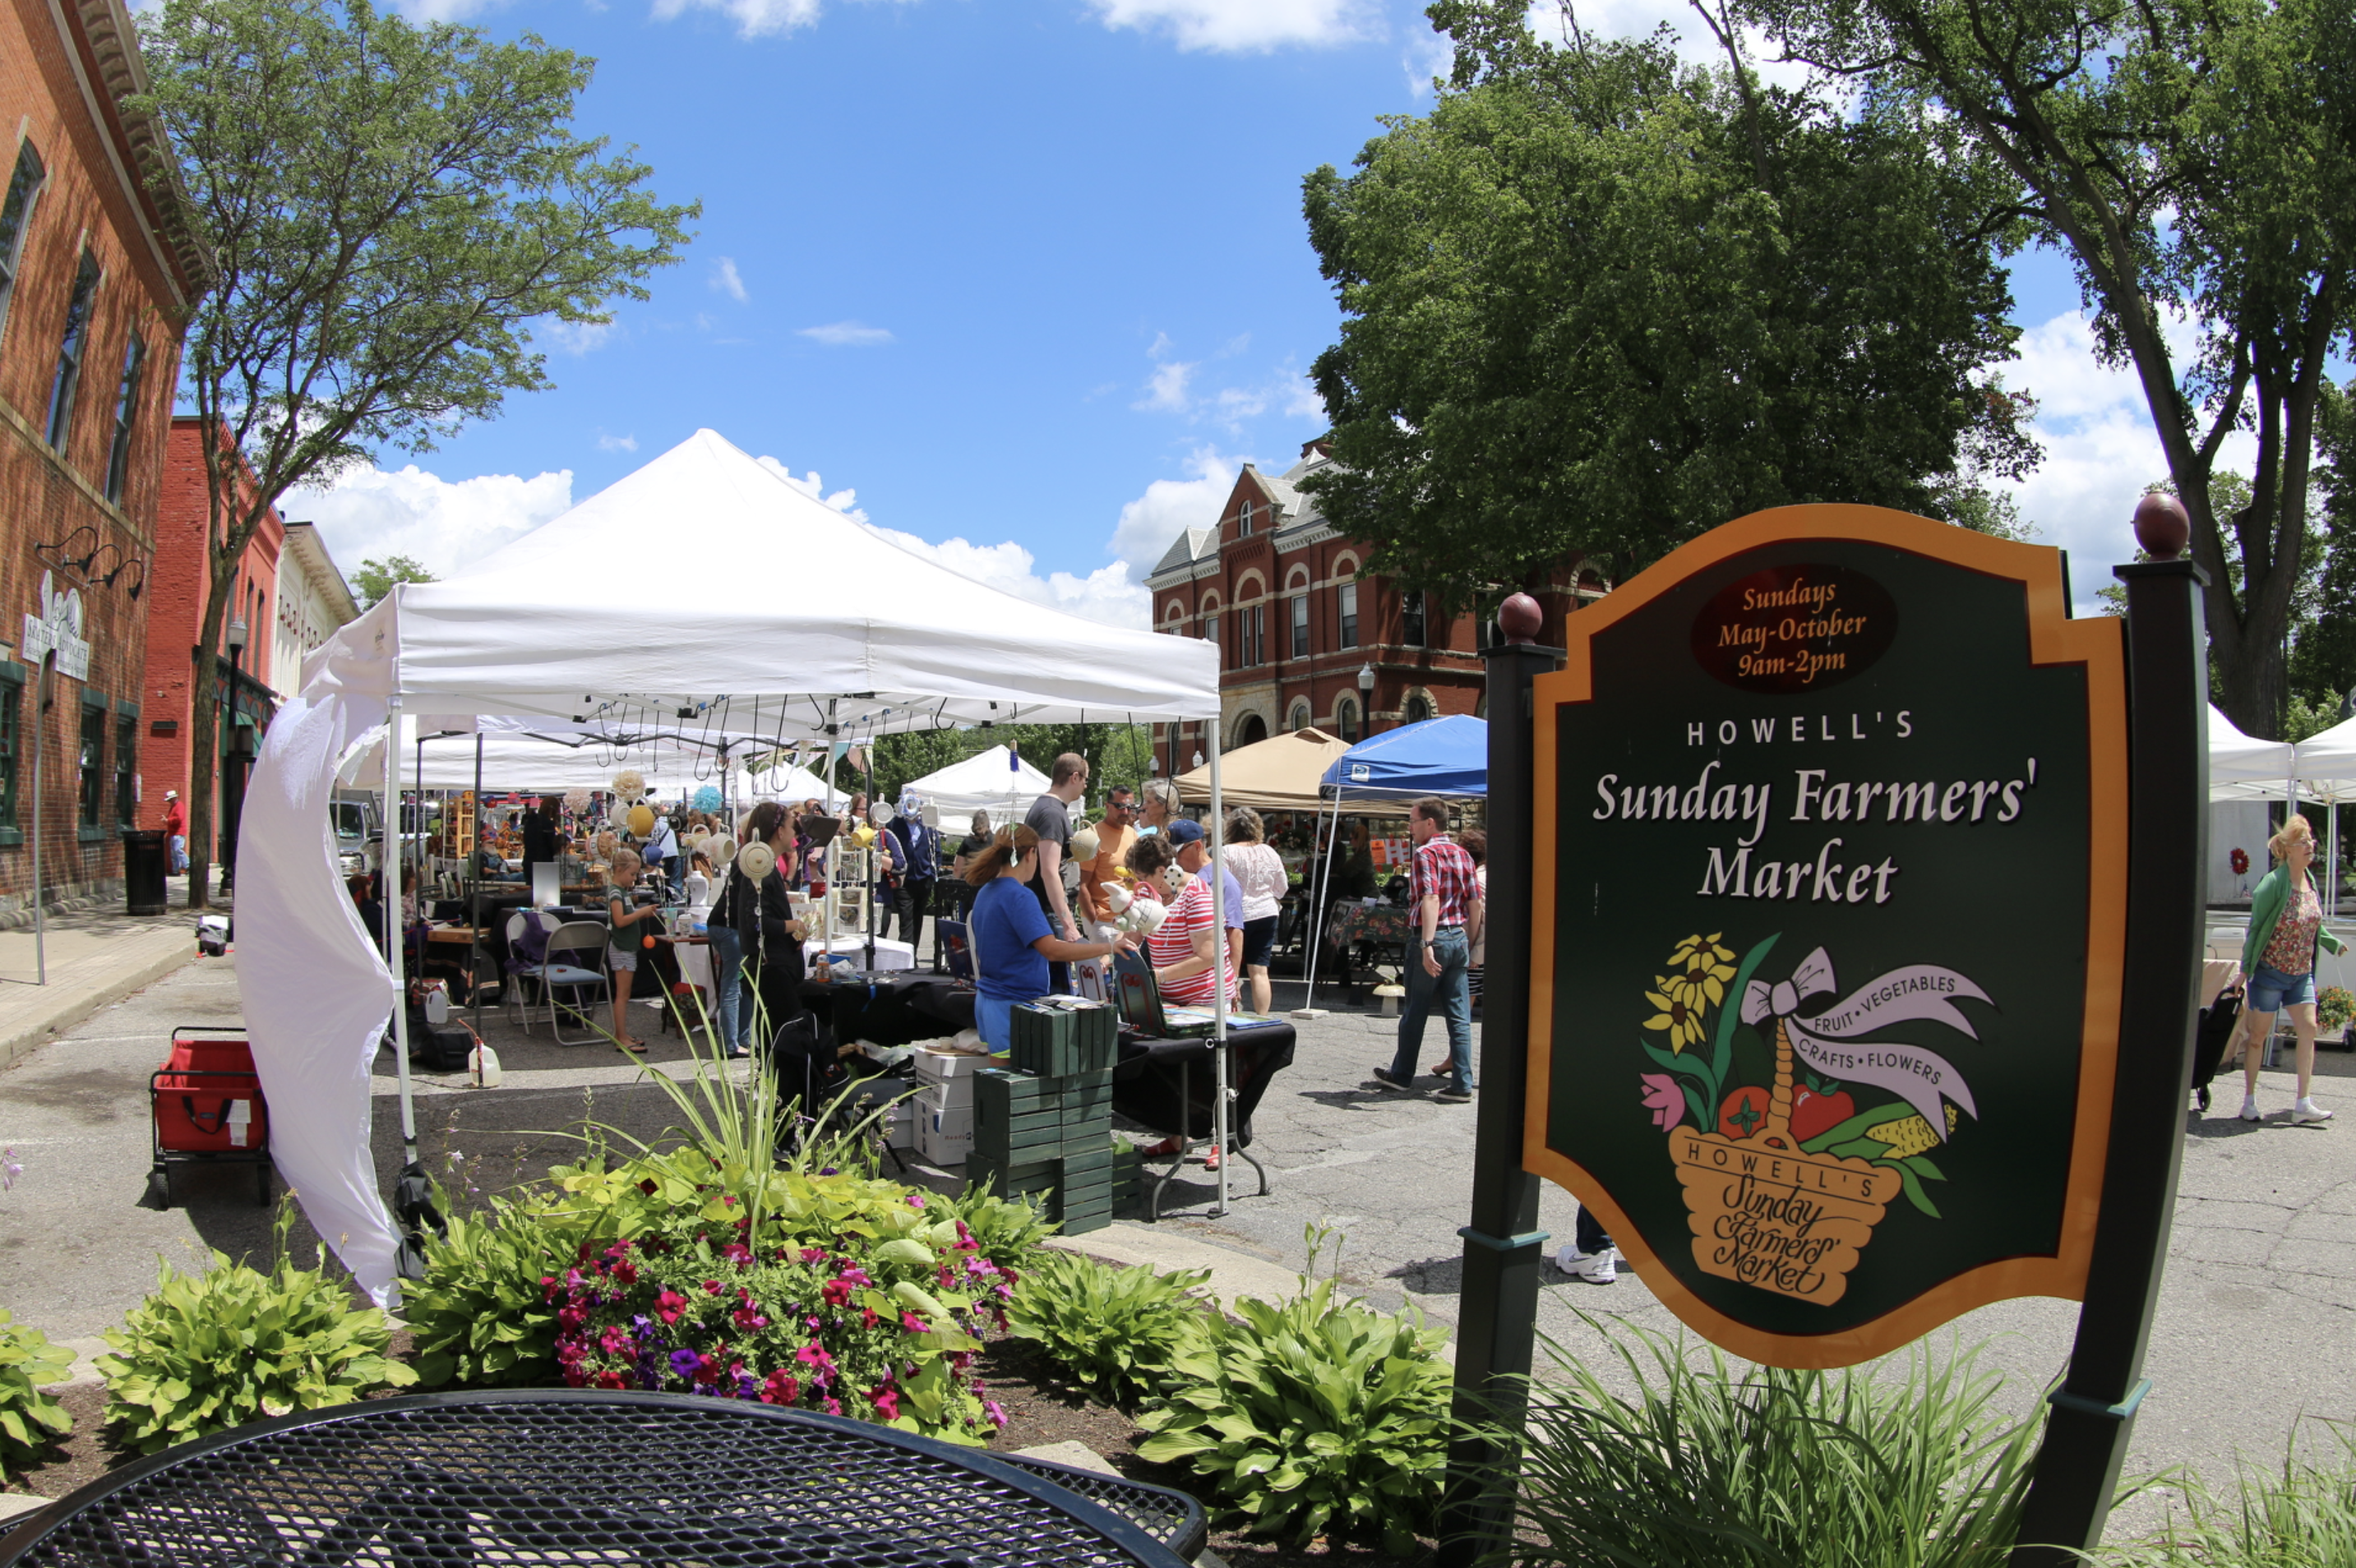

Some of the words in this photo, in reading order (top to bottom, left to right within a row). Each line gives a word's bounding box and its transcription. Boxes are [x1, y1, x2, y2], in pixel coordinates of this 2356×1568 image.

[1742, 577, 1836, 614] Sundays
[58, 635, 88, 662] ADVOCATE
[1716, 608, 1867, 654] May-October
[1738, 649, 1846, 683] 9am-2pm
[1688, 710, 1913, 746] HOWELL'S
[1592, 760, 1772, 846] Sunday
[1790, 758, 2037, 824] Farmers'
[1697, 838, 1899, 905] Market
[1813, 1010, 1854, 1033] FRUIT
[1860, 975, 1956, 1013] VEGETABLES
[1799, 1038, 1855, 1069] CRAFTS
[1868, 1053, 1942, 1086] FLOWERS
[1688, 1142, 1873, 1198] HOWELL'S
[1722, 1174, 1861, 1232] Sunday
[1713, 1211, 1841, 1265] Farmers'
[1713, 1235, 1825, 1294] Market
